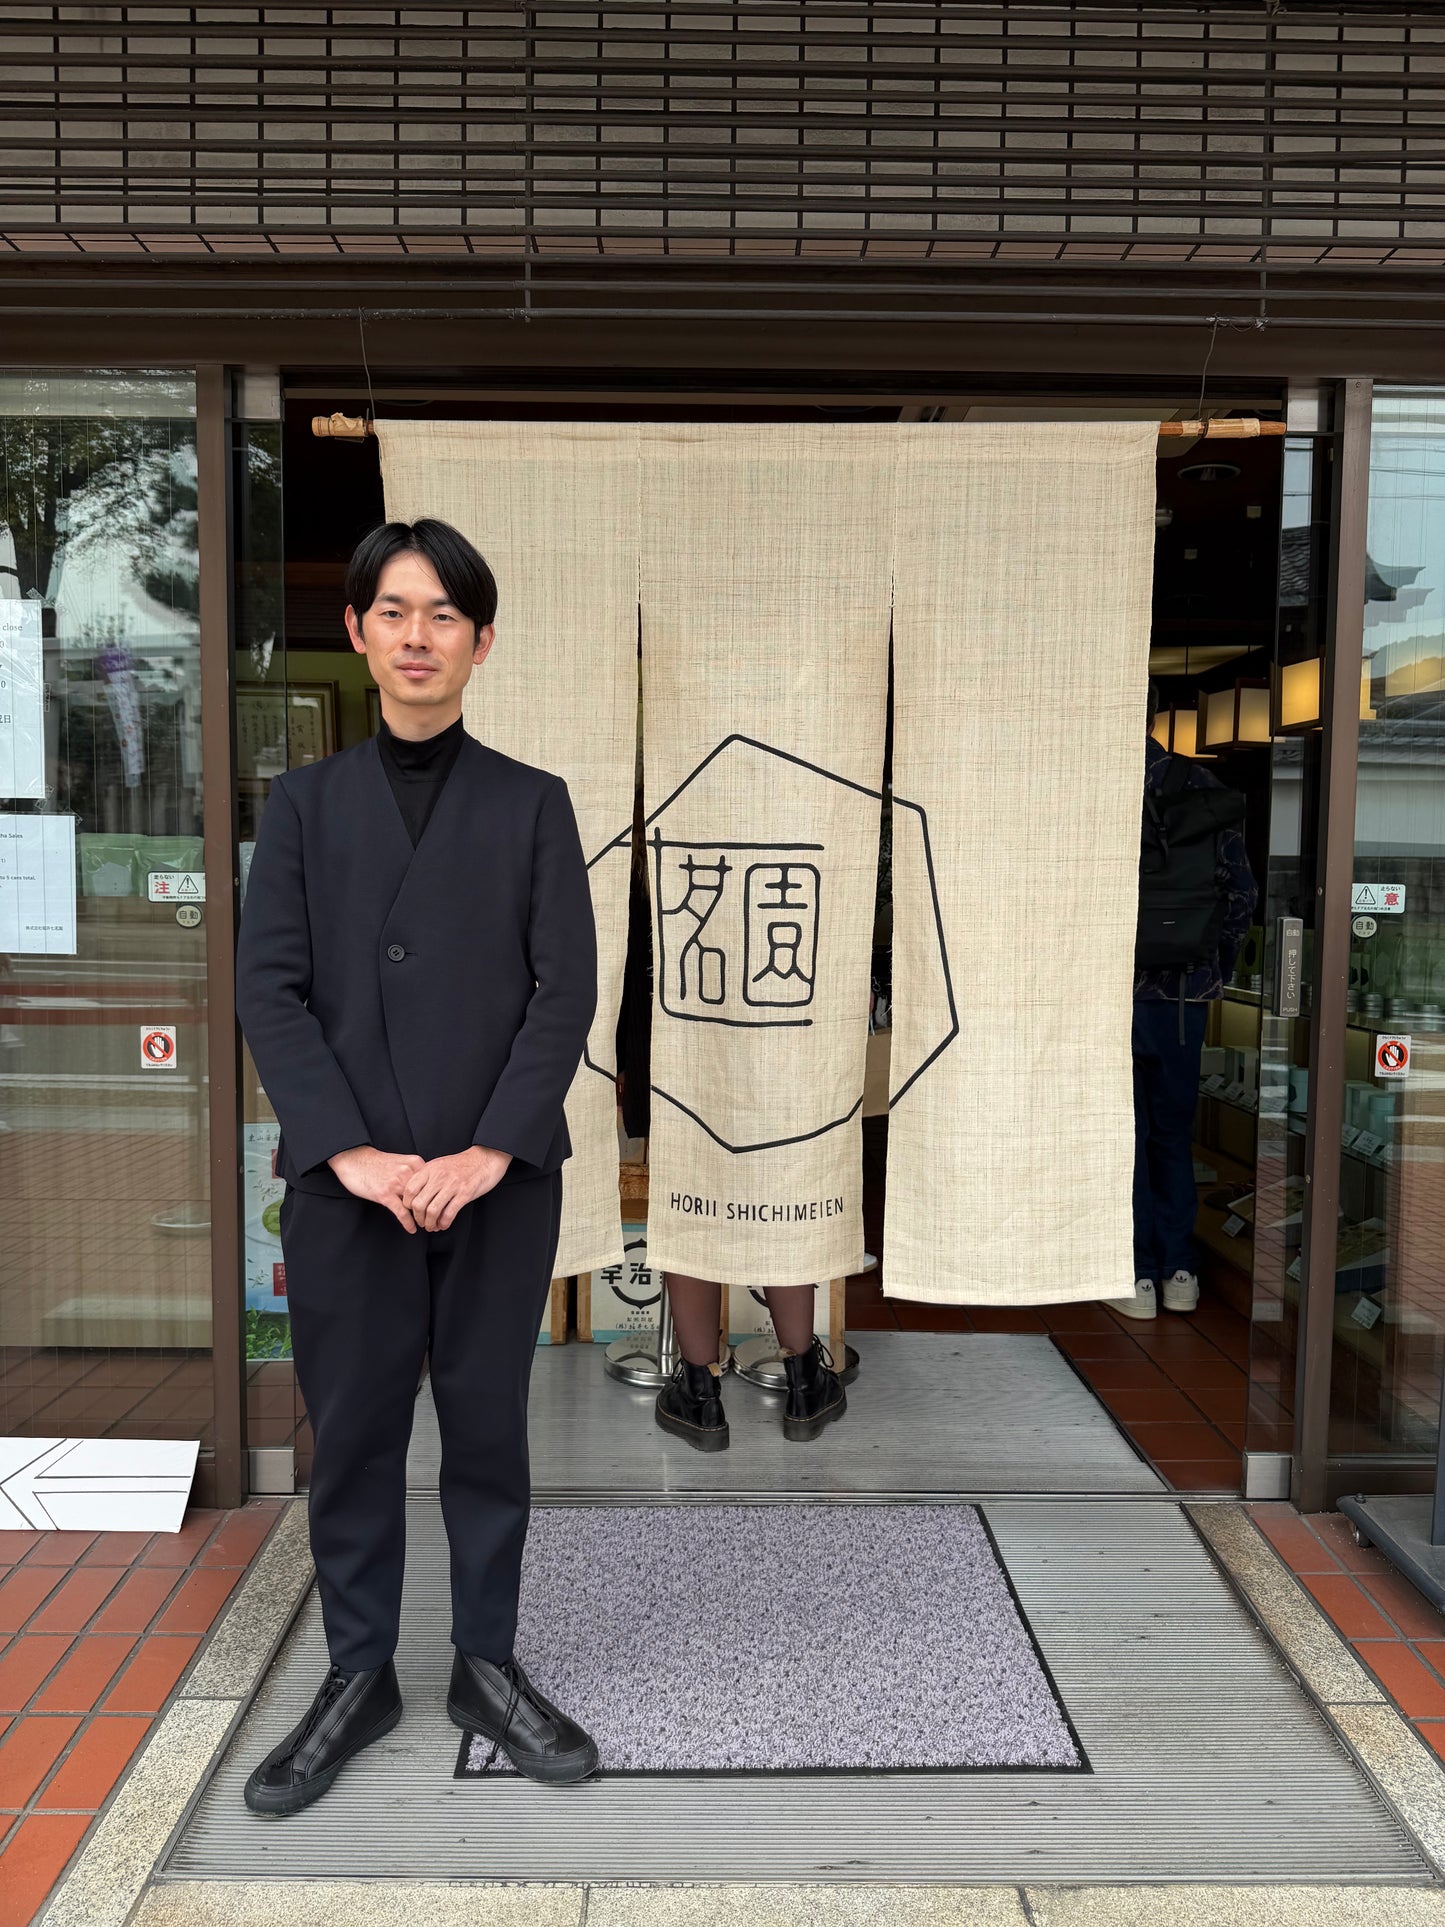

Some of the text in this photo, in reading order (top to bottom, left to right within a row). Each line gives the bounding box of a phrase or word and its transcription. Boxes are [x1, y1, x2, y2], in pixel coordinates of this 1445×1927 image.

[2, 623, 23, 631] close
[154, 881, 170, 894] 注
[1384, 892, 1400, 906] 意
[179, 910, 199, 920] 自動
[1355, 921, 1375, 931] 自動
[1286, 928, 1300, 937] 自動
[671, 1192, 844, 1222] HORII SHICHIMEIEN
[600, 1263, 662, 1285] 宇治
